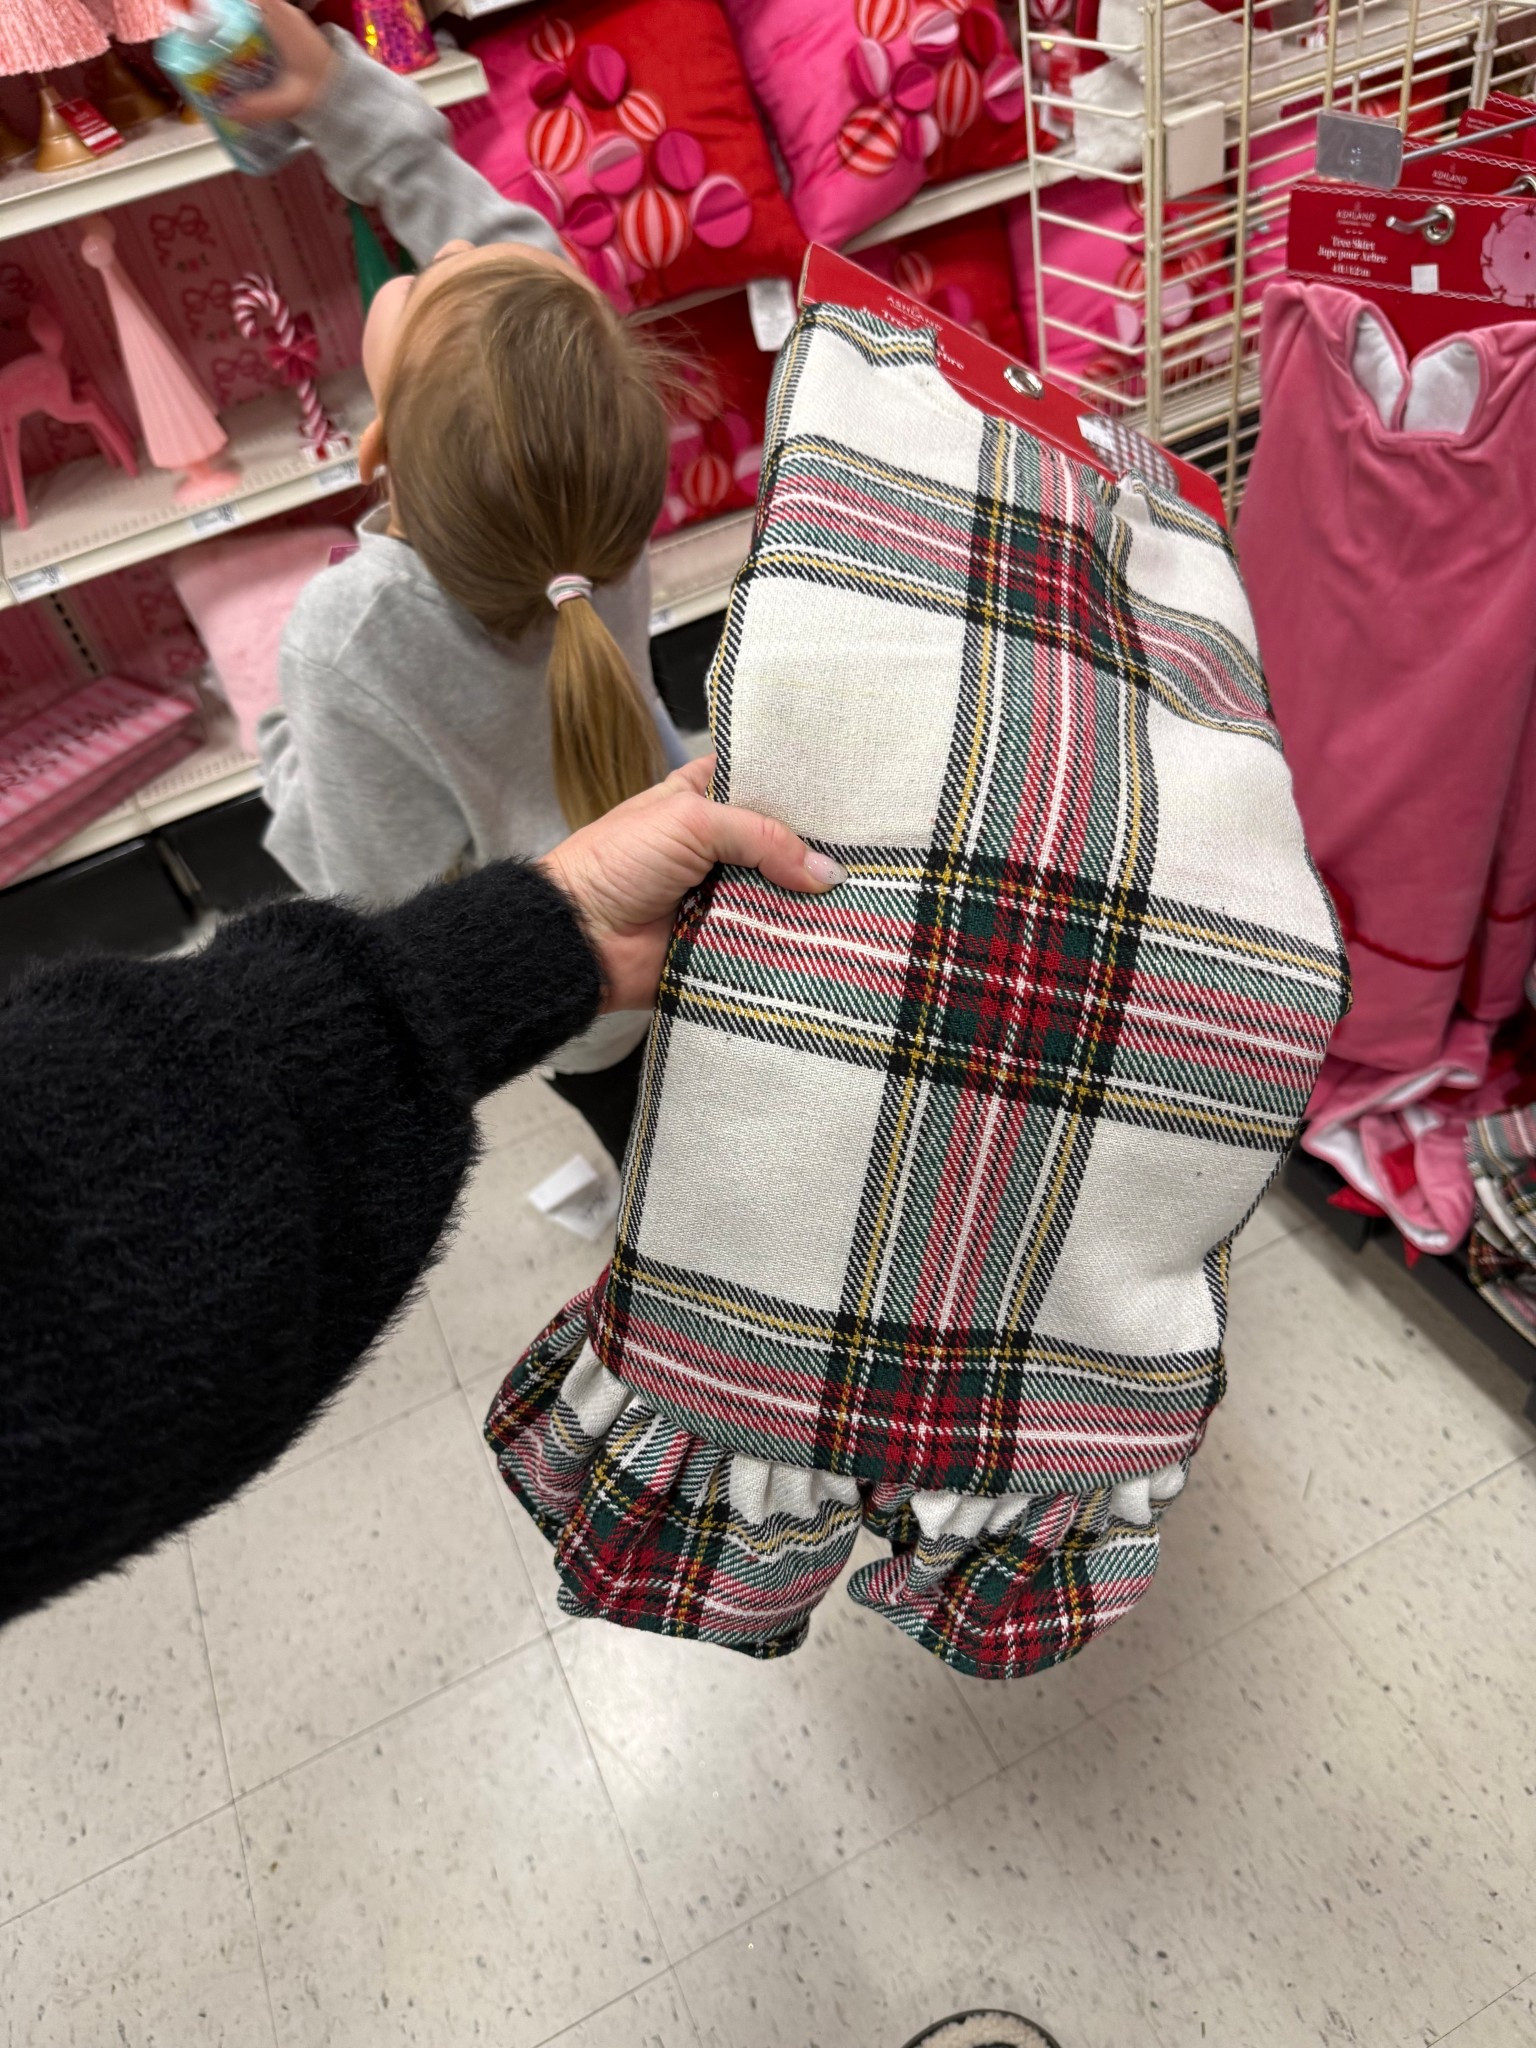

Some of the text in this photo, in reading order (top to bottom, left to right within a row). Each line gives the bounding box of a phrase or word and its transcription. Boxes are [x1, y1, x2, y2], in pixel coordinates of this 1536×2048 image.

[1331, 235, 1376, 251] Tree Skirt
[1337, 248, 1361, 261] pour
[887, 296, 943, 332] ASHLAND
[937, 350, 965, 371] rbre
